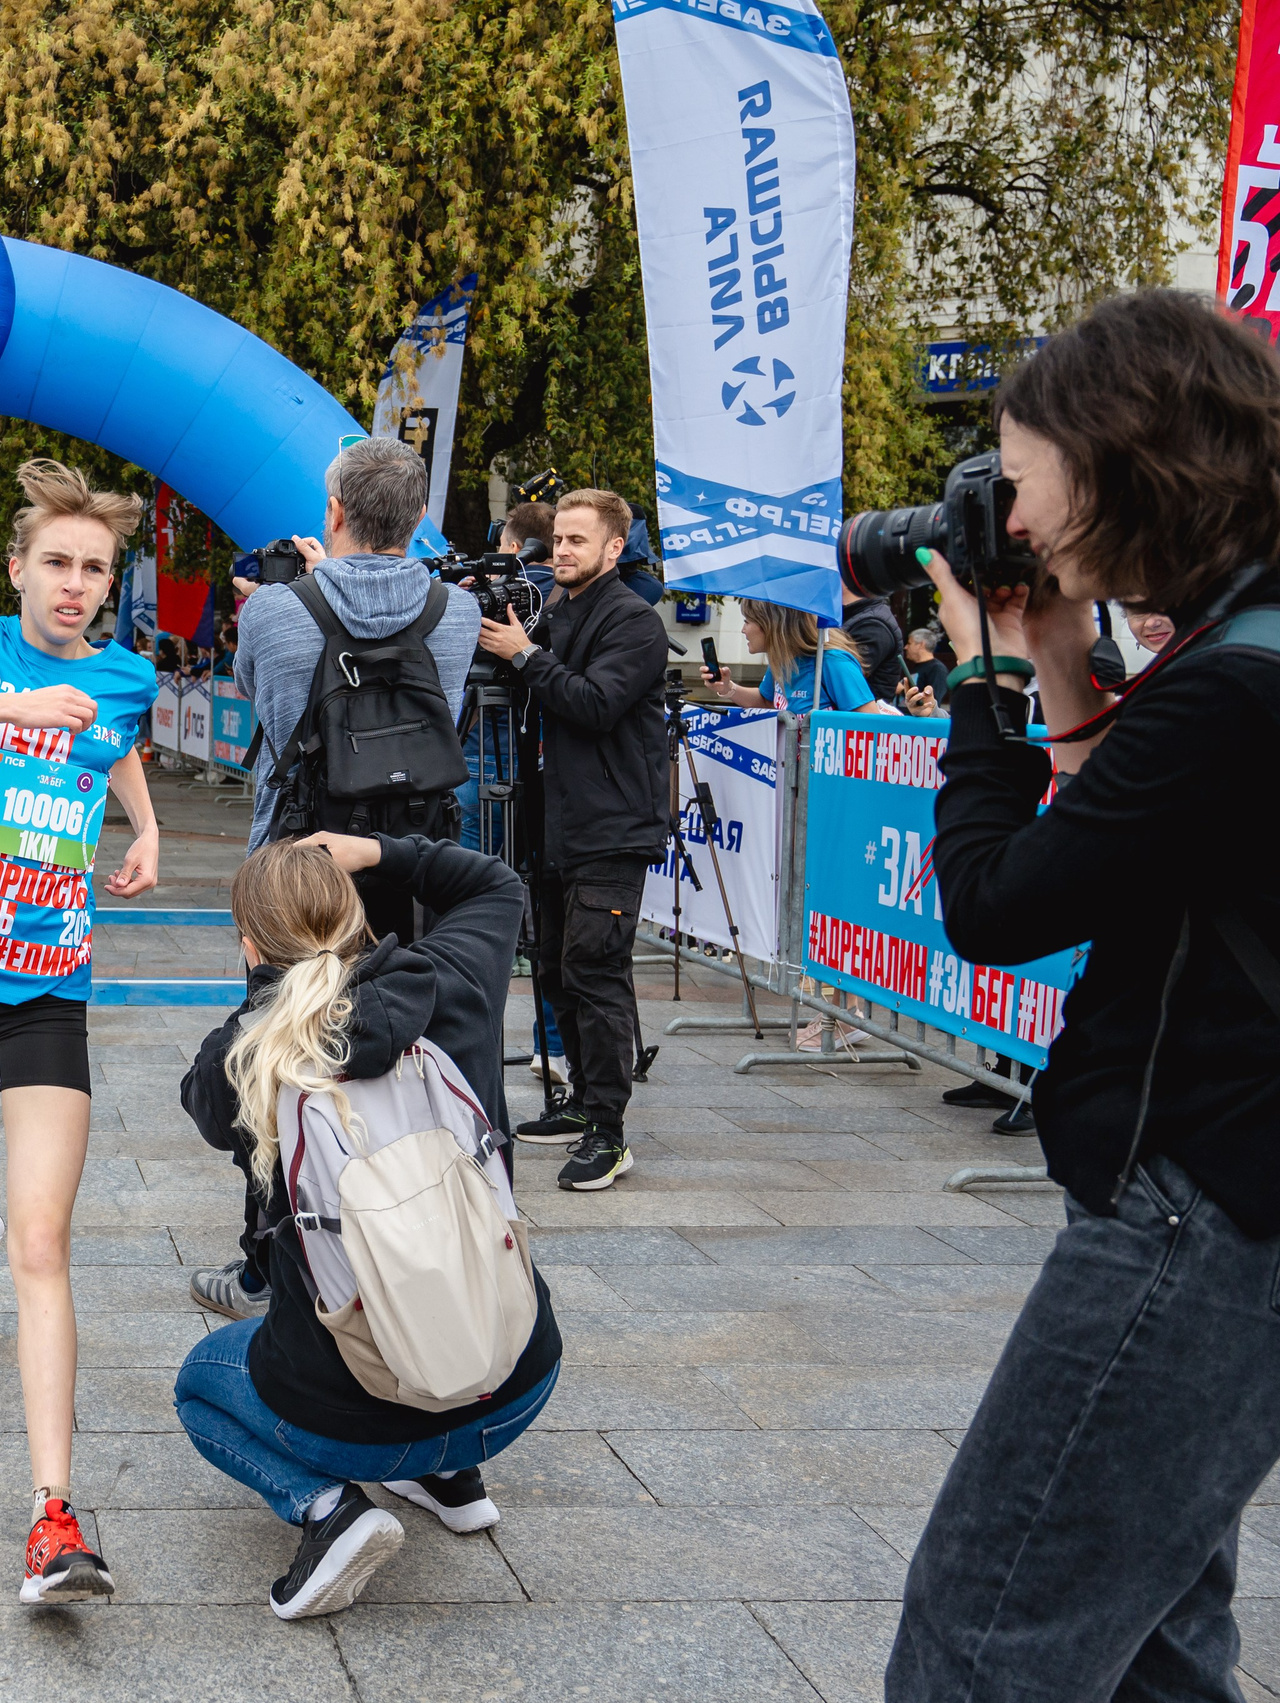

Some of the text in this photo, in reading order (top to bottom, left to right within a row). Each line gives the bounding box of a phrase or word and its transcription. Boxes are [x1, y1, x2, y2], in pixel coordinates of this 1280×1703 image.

[5, 756, 26, 768] ПСБ
[814, 727, 874, 780] #ЗАБЕГ
[3, 787, 85, 836] 10006
[18, 830, 58, 864] 1КМ
[808, 911, 928, 1002] #АДРЕНАЛИН
[929, 950, 1015, 1034] #ЗАБЕГ
